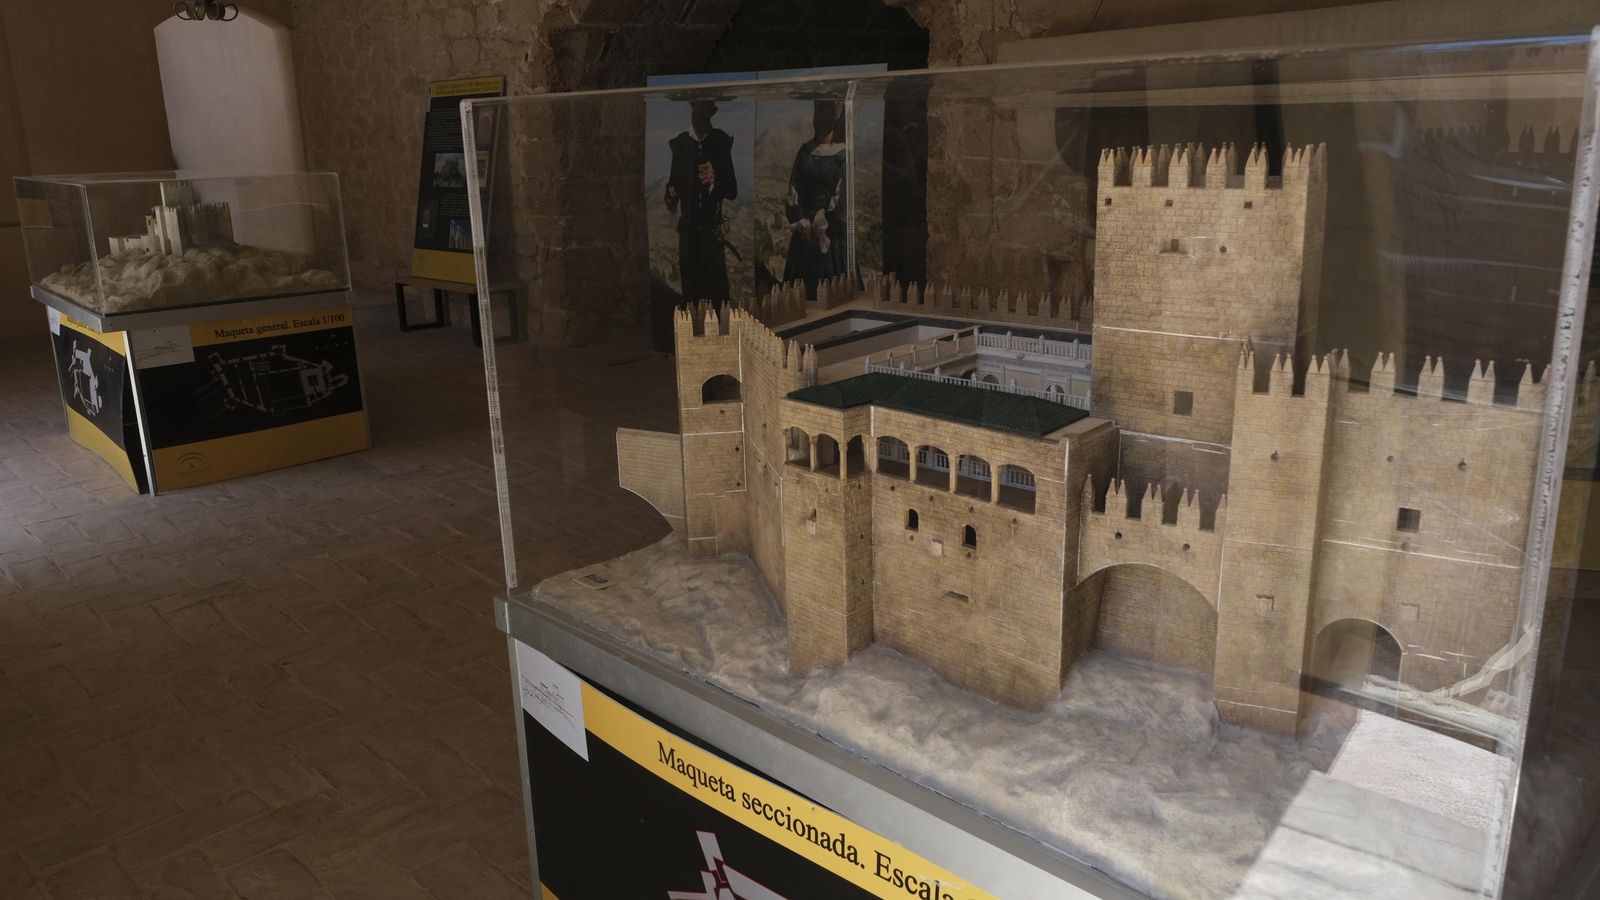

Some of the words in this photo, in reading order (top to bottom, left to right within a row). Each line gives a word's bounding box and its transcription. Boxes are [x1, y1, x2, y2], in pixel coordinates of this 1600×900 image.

[214, 327, 254, 339] Maqueta
[256, 321, 291, 335] general.
[293, 316, 320, 328] Escala
[322, 313, 345, 325] 1/100
[656, 741, 736, 802] Maqueta
[741, 792, 866, 869] seccionada.
